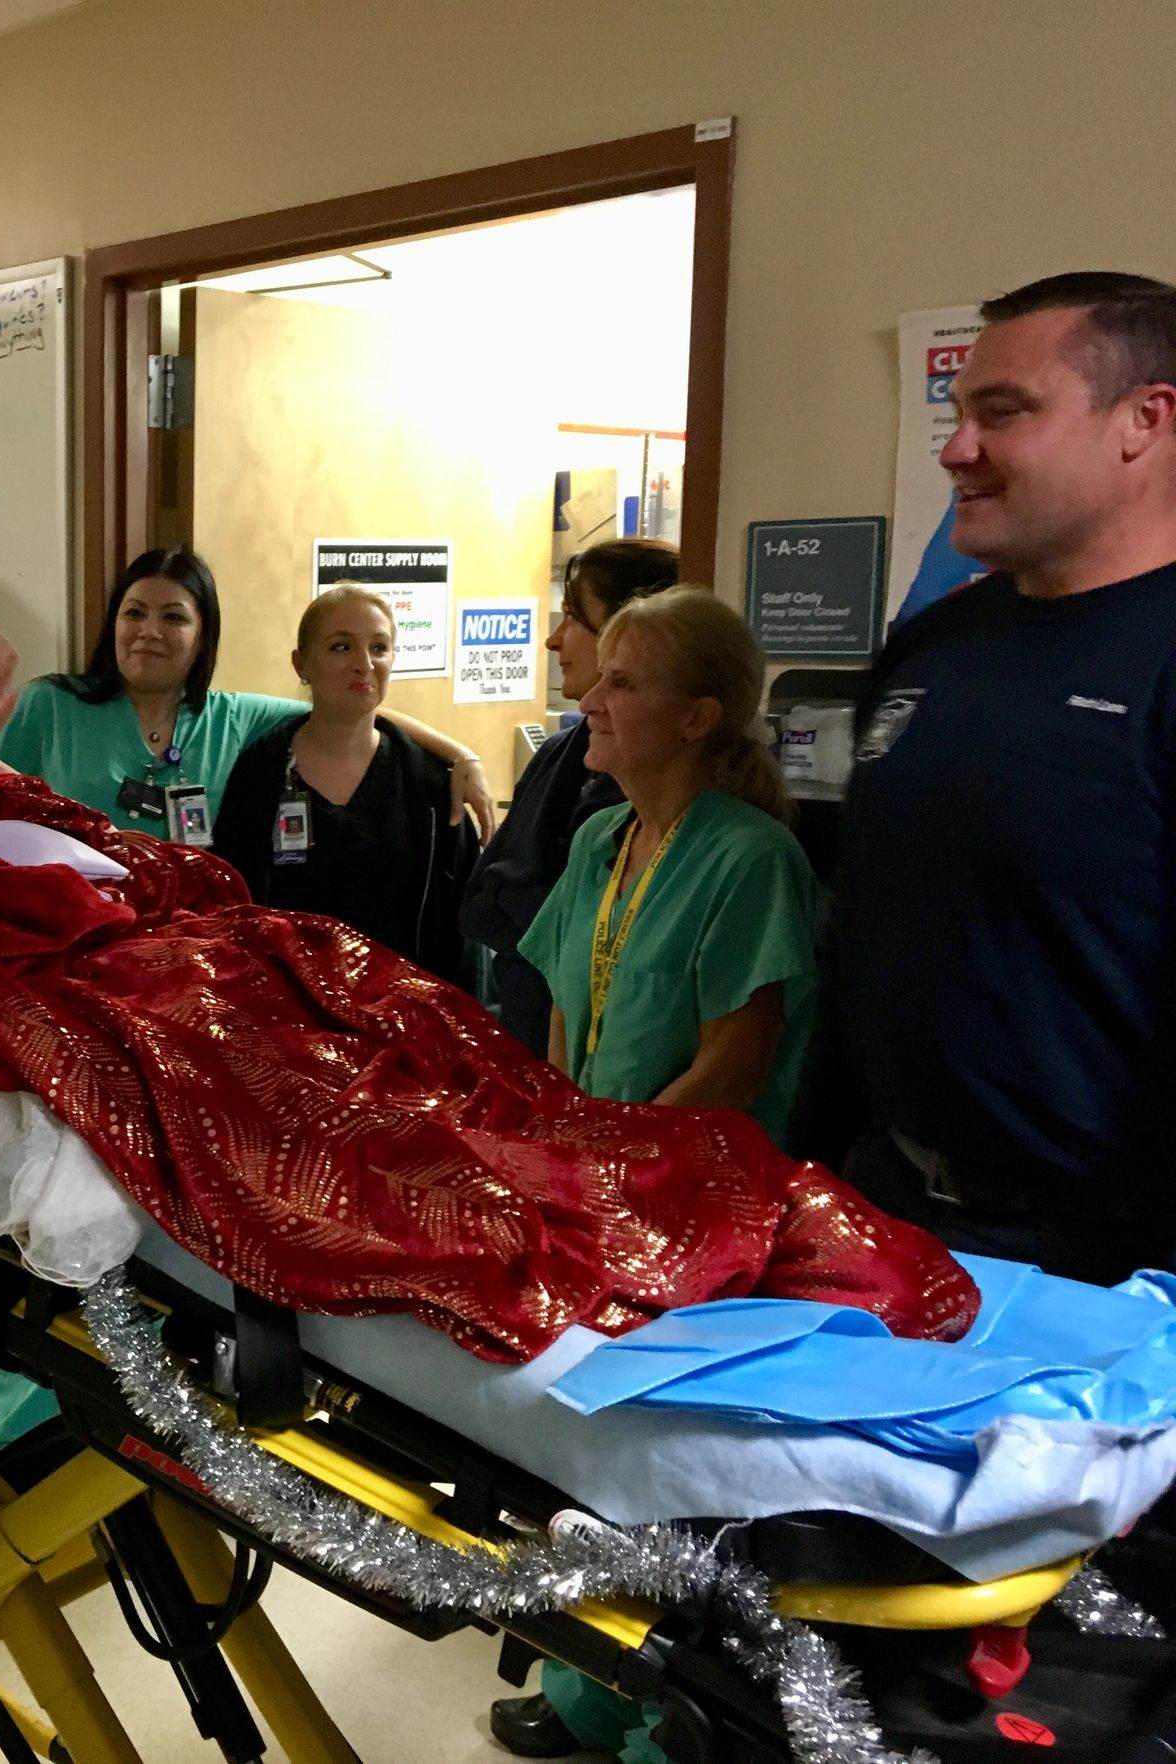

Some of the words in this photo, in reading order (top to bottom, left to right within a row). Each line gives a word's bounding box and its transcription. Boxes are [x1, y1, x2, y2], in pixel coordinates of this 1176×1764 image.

[933, 351, 965, 371] CL
[764, 538, 821, 556] 1-A-52
[319, 552, 347, 567] BURN
[348, 552, 384, 567] CENTER
[385, 552, 419, 566] SUPPLY
[420, 552, 447, 566] ROOM
[761, 592, 791, 605] Staff
[792, 592, 823, 607] Only
[787, 607, 813, 617] Door
[813, 607, 851, 617] Closed
[397, 620, 433, 632] Hygiene
[463, 614, 529, 640] NOTICE
[468, 651, 480, 664] DO
[483, 650, 499, 663] NOT
[500, 650, 523, 663] PROP
[461, 667, 483, 681] OPEN
[485, 667, 503, 680] THIS
[505, 666, 528, 680] DOOR
